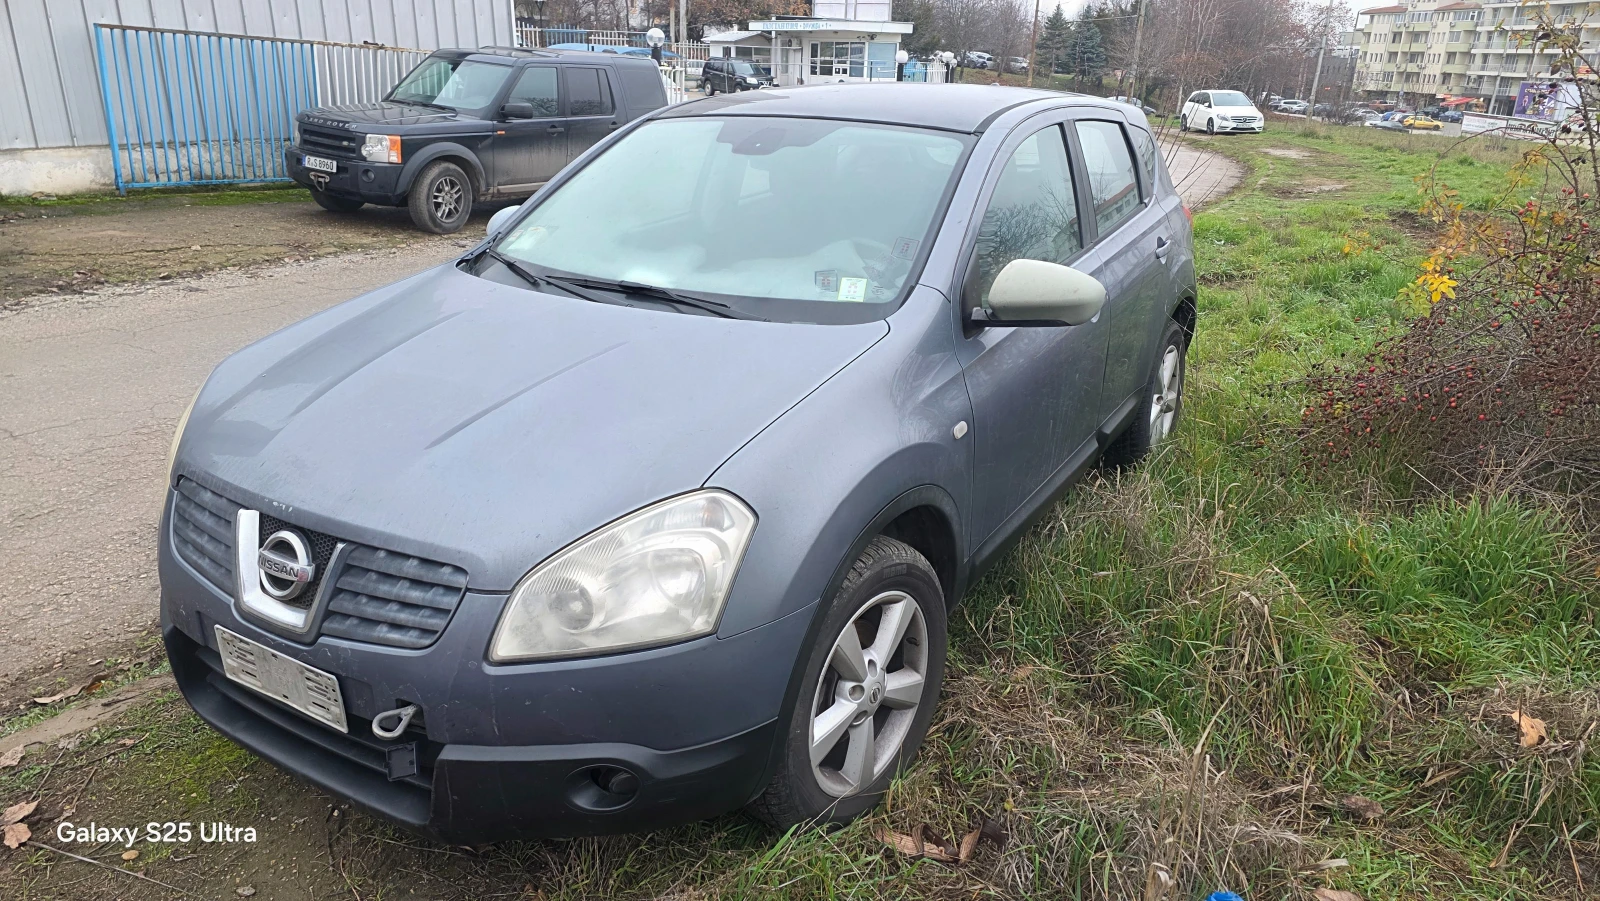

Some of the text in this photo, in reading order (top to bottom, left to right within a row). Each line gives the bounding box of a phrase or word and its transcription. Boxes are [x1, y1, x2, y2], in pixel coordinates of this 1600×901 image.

[304, 116, 358, 129] LAND ROVER
[259, 555, 299, 578] NISSAN
